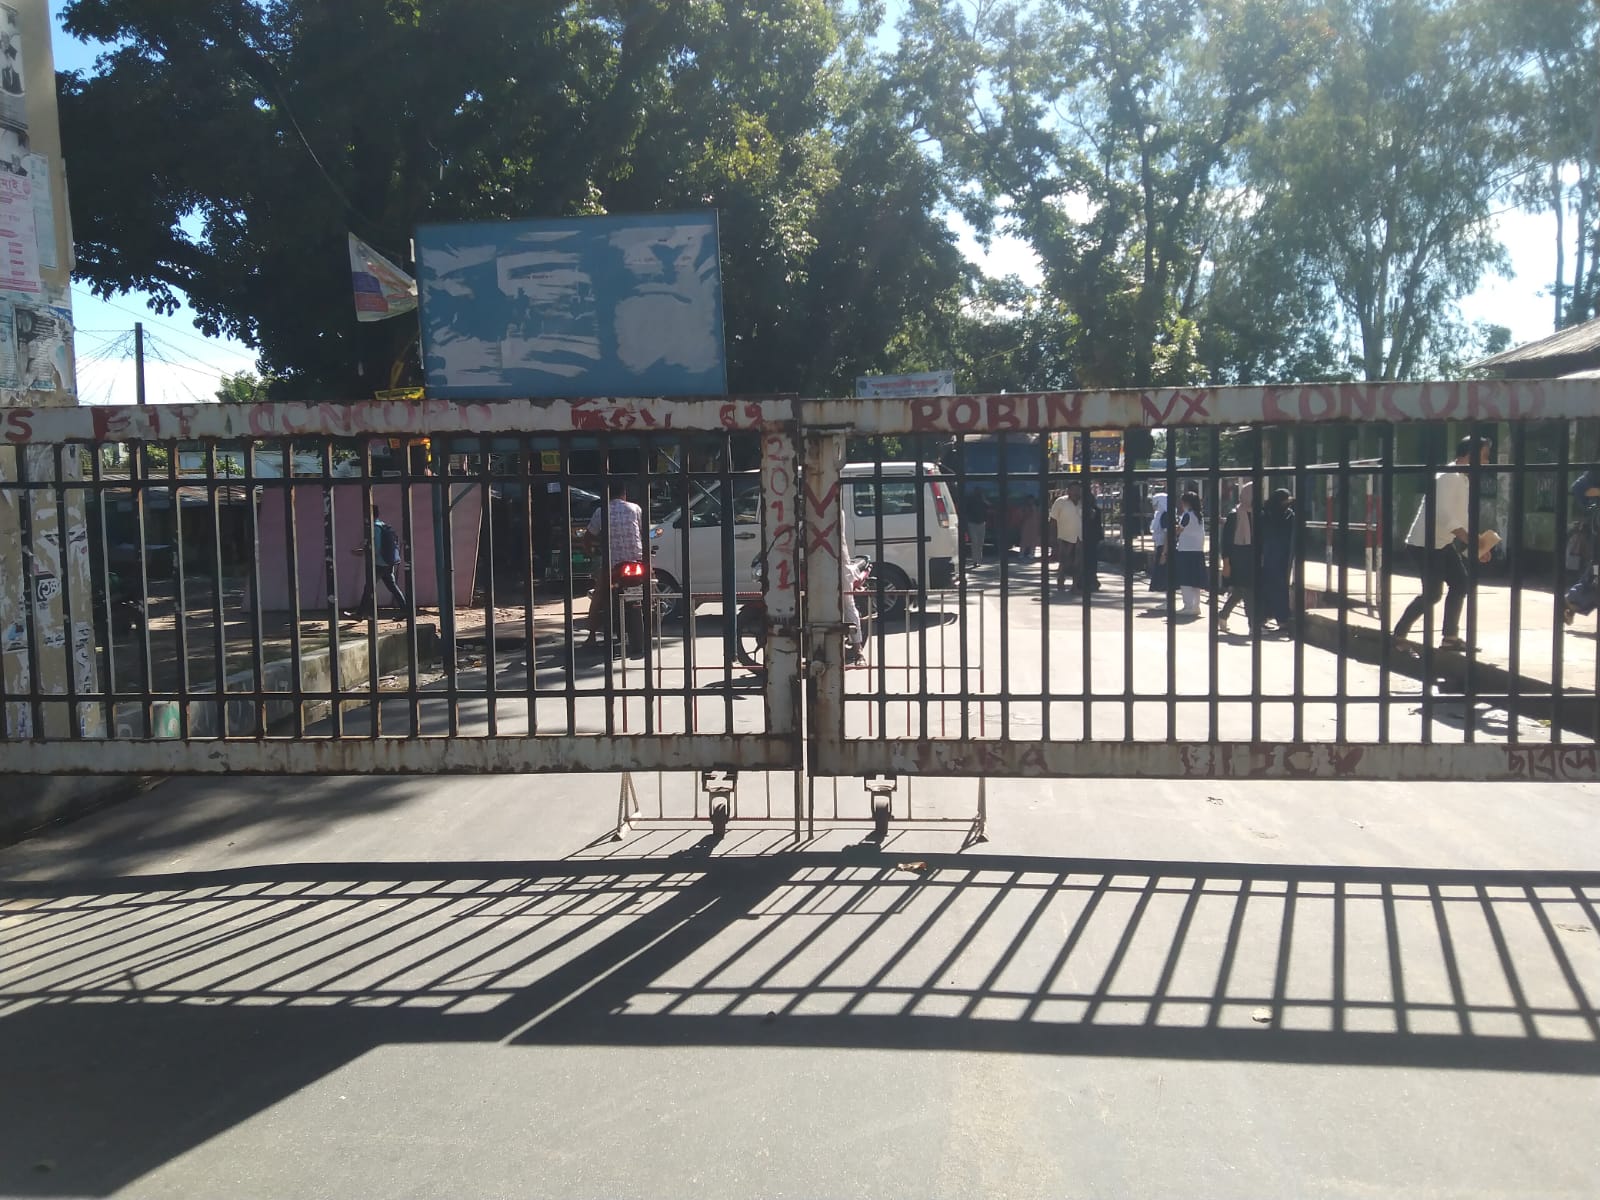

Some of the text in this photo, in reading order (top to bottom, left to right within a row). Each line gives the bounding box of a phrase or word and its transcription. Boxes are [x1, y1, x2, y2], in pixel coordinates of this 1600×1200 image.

[910, 381, 1545, 432] ROBIN VX CONCORD
